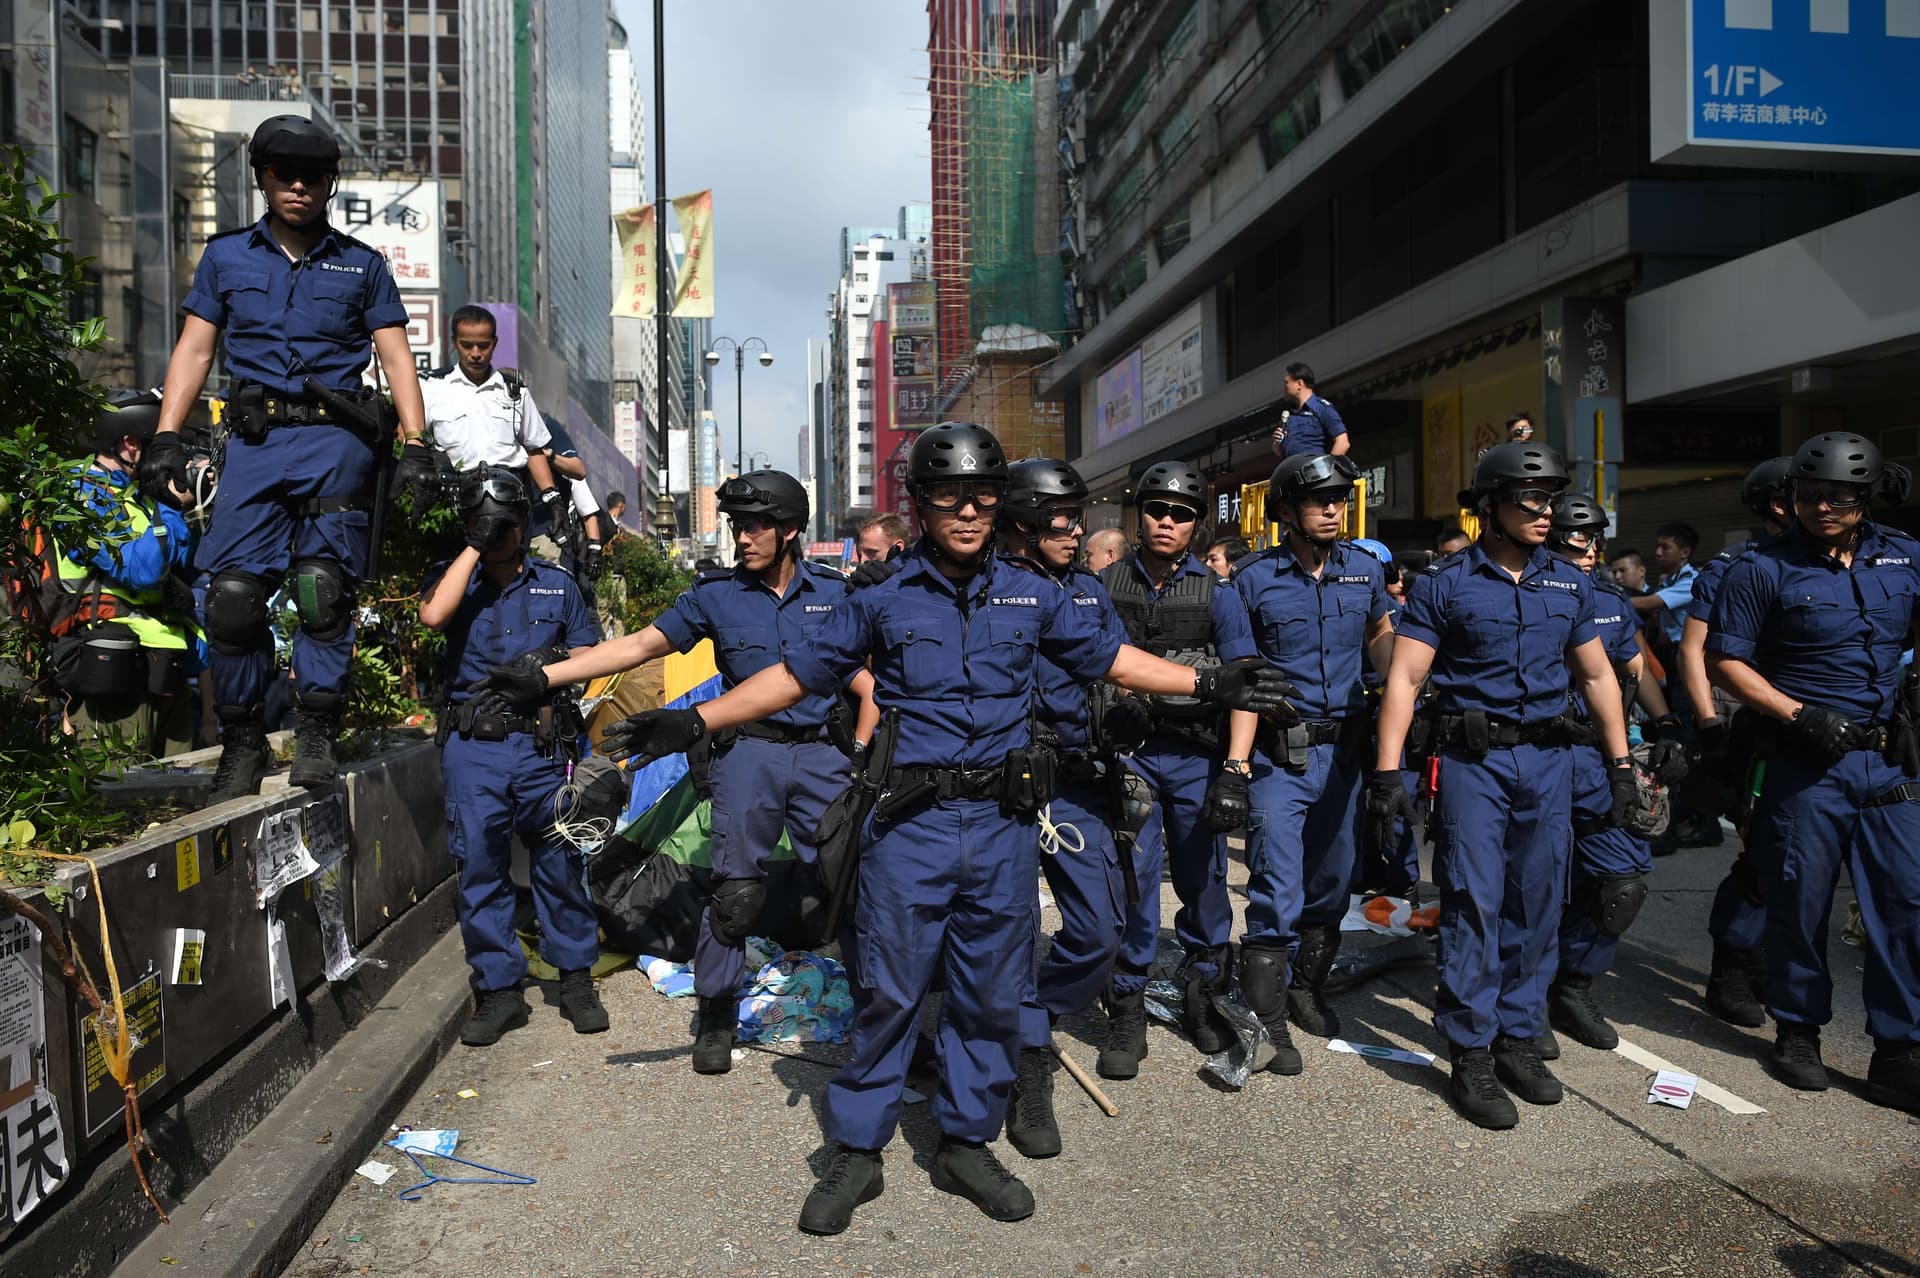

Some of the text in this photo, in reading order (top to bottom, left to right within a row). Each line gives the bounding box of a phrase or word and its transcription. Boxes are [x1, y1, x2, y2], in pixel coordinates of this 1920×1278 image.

[1703, 64, 1756, 97] 1/F
[1702, 102, 1828, 126] 荷李活商業中心
[331, 265, 356, 273] POLICE
[1219, 491, 1241, 525] 周大
